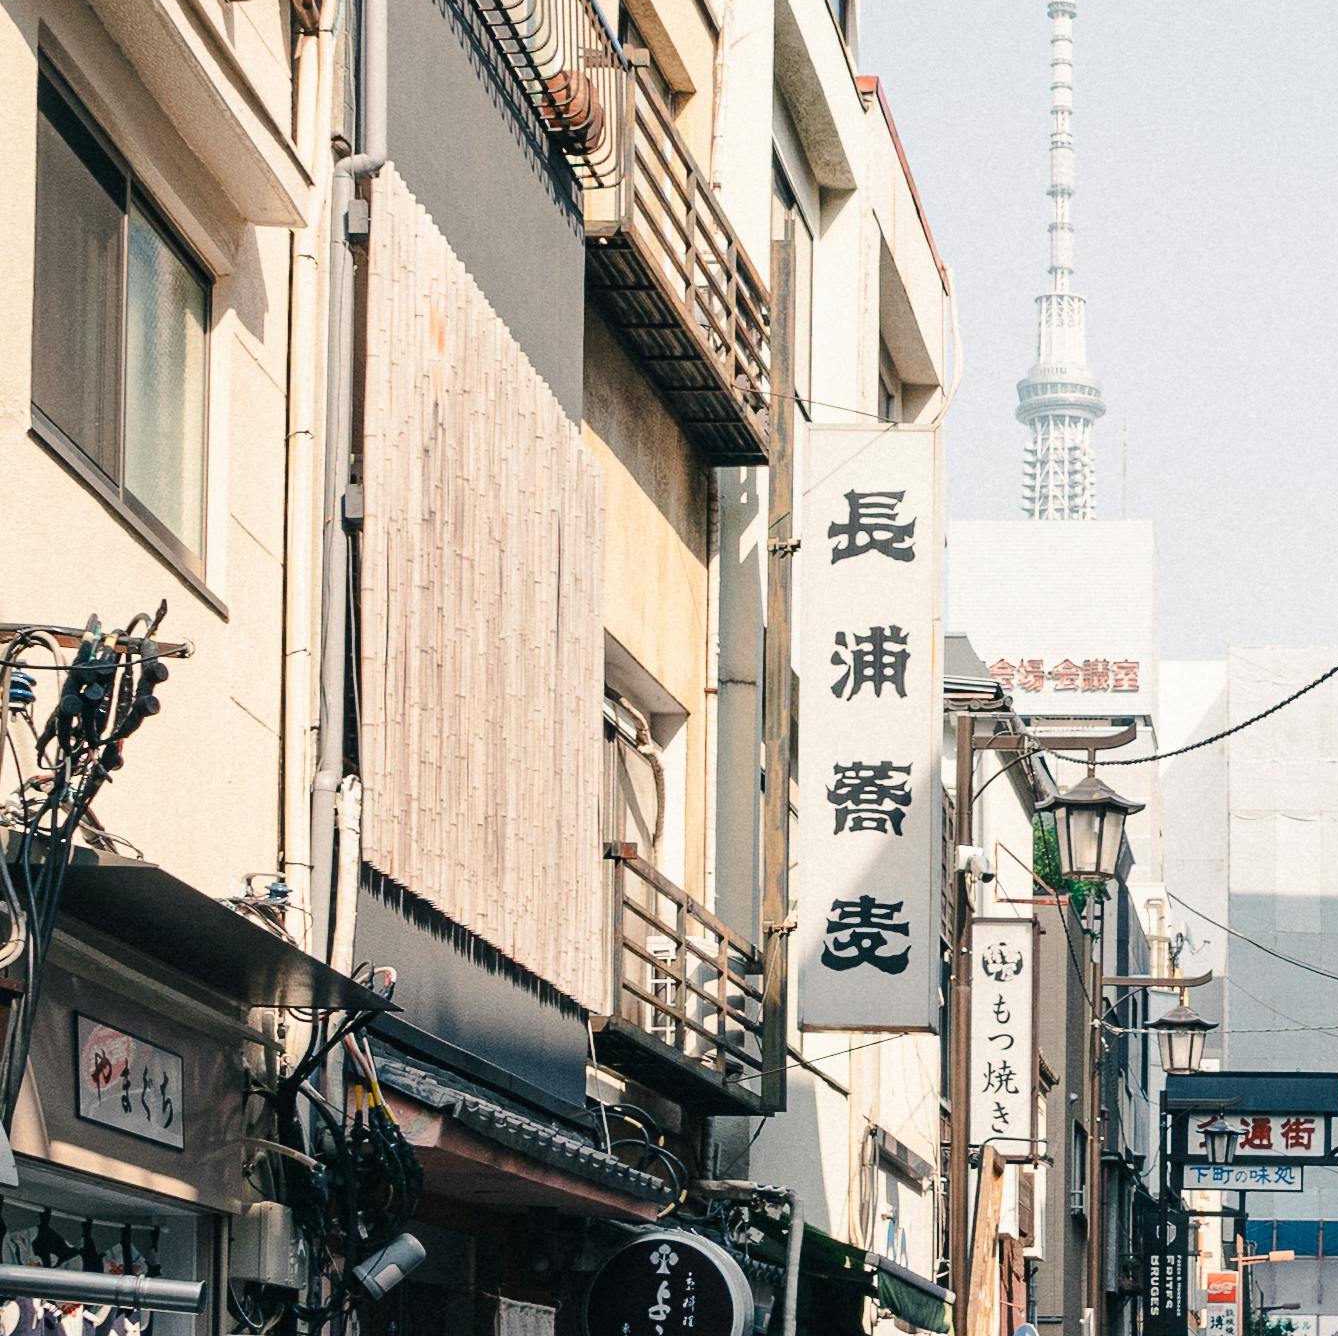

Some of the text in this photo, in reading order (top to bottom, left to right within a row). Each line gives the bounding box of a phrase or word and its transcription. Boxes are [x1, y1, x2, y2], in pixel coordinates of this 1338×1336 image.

[820, 488, 917, 975] 長浦蕎麦
[981, 993, 1020, 1135] もつ焼き
[1190, 1166, 1297, 1186] 下町の味処
